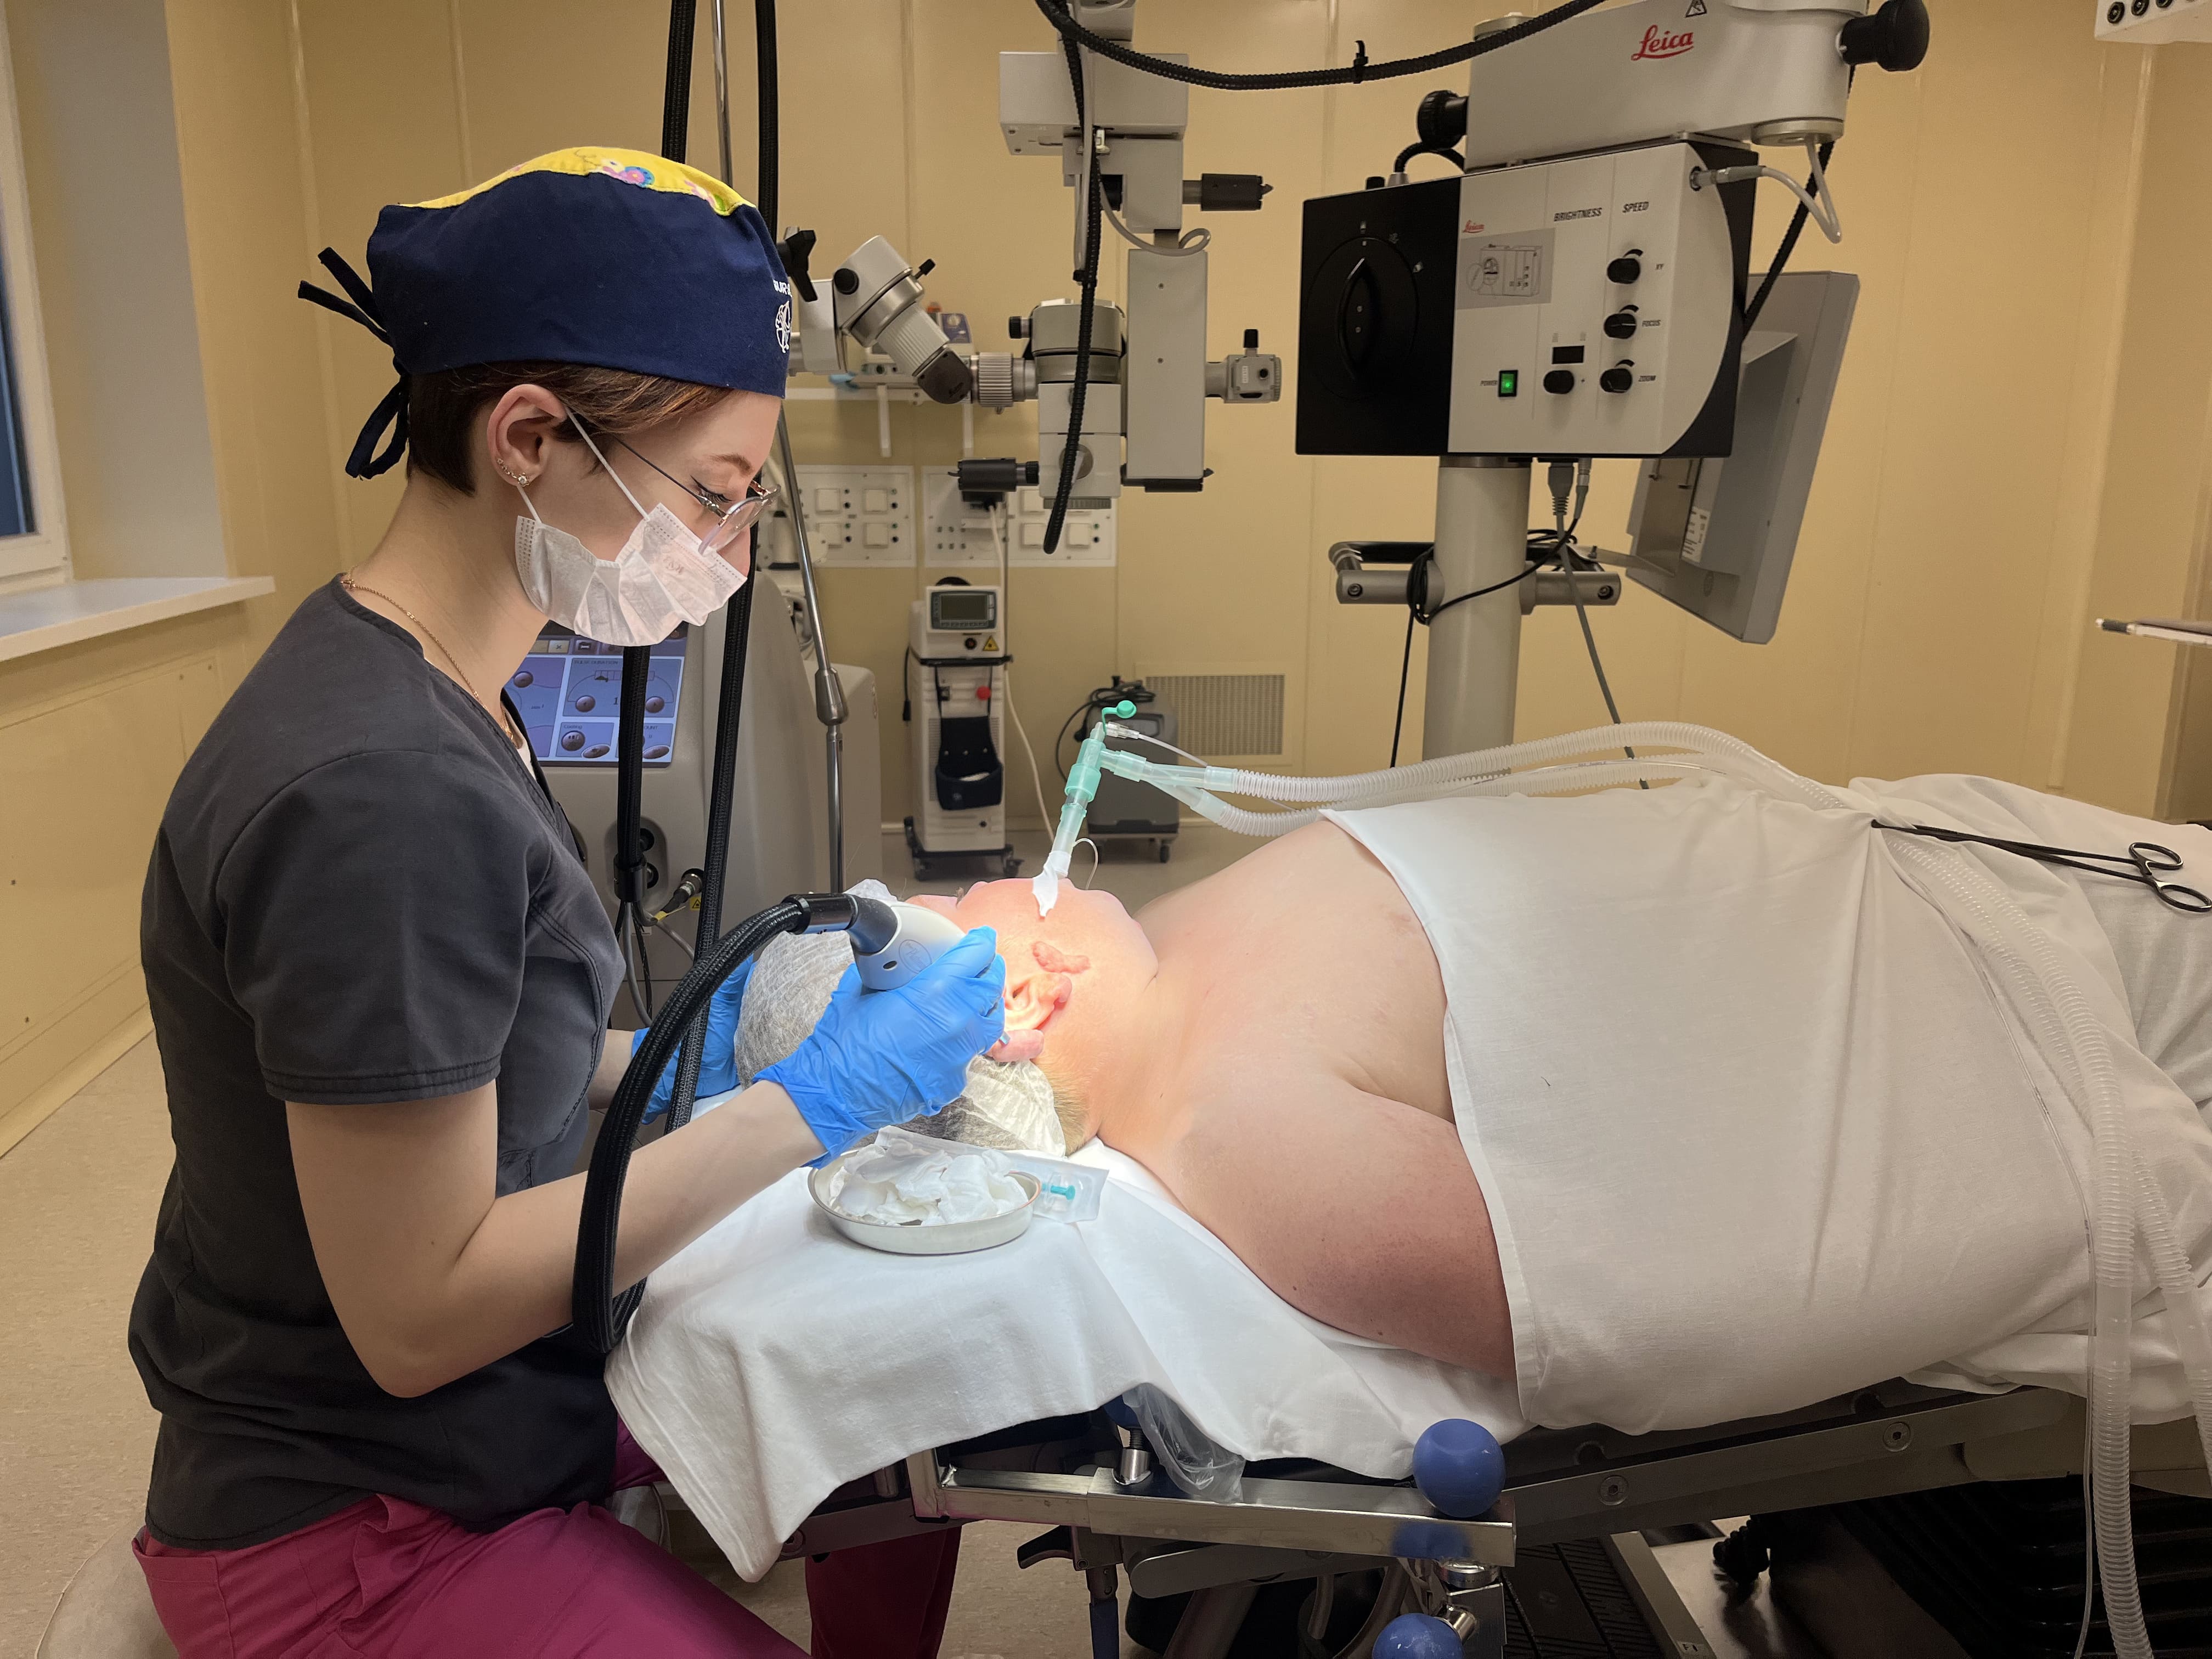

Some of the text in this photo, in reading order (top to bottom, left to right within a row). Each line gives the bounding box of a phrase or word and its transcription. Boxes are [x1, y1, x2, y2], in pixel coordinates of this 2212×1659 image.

[1630, 24, 1695, 61] Leica
[1554, 207, 1602, 222] BRIGHTNESS
[1622, 201, 1649, 213] SPEED
